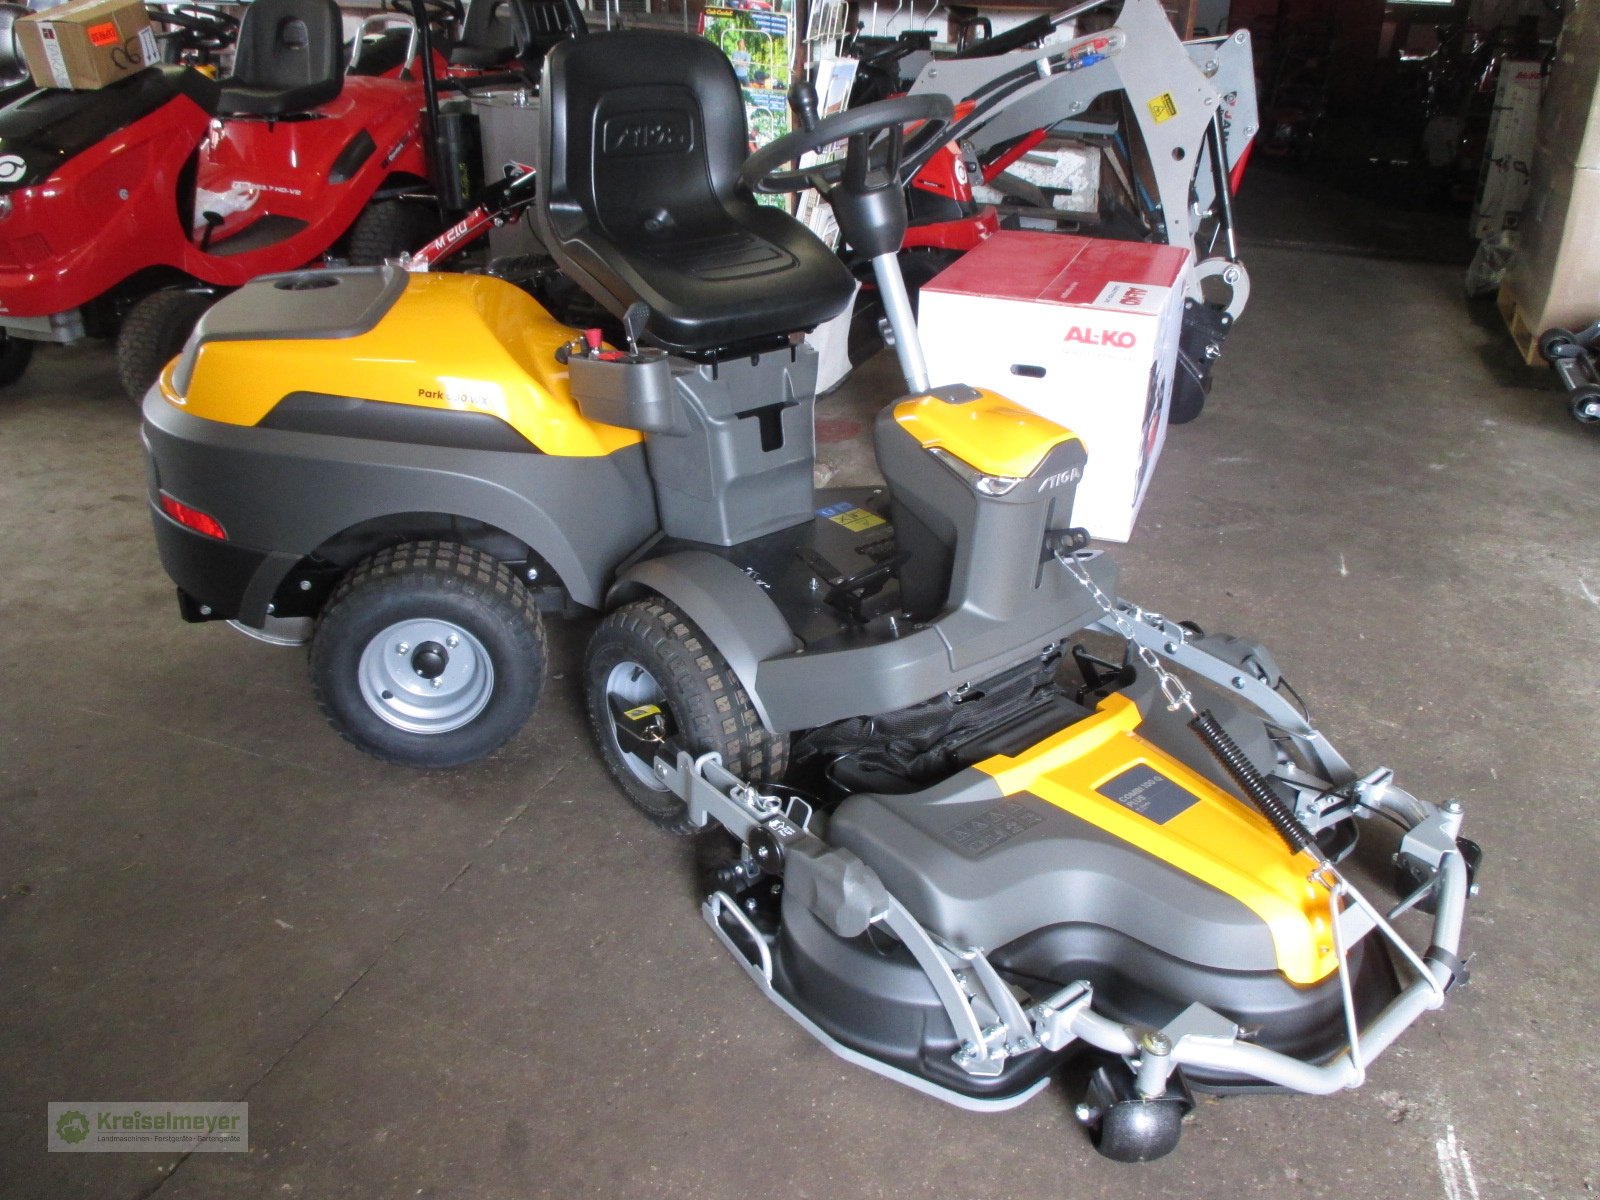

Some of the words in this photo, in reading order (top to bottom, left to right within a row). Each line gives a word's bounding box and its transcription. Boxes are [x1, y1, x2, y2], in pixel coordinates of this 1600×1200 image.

[435, 235, 446, 250] M
[447, 220, 468, 242] 210
[1063, 325, 1137, 349] AL-KO
[418, 388, 443, 399] Park
[1038, 467, 1081, 493] STIGA
[1118, 786, 1144, 803] COMBI
[1126, 795, 1146, 808] PLUS
